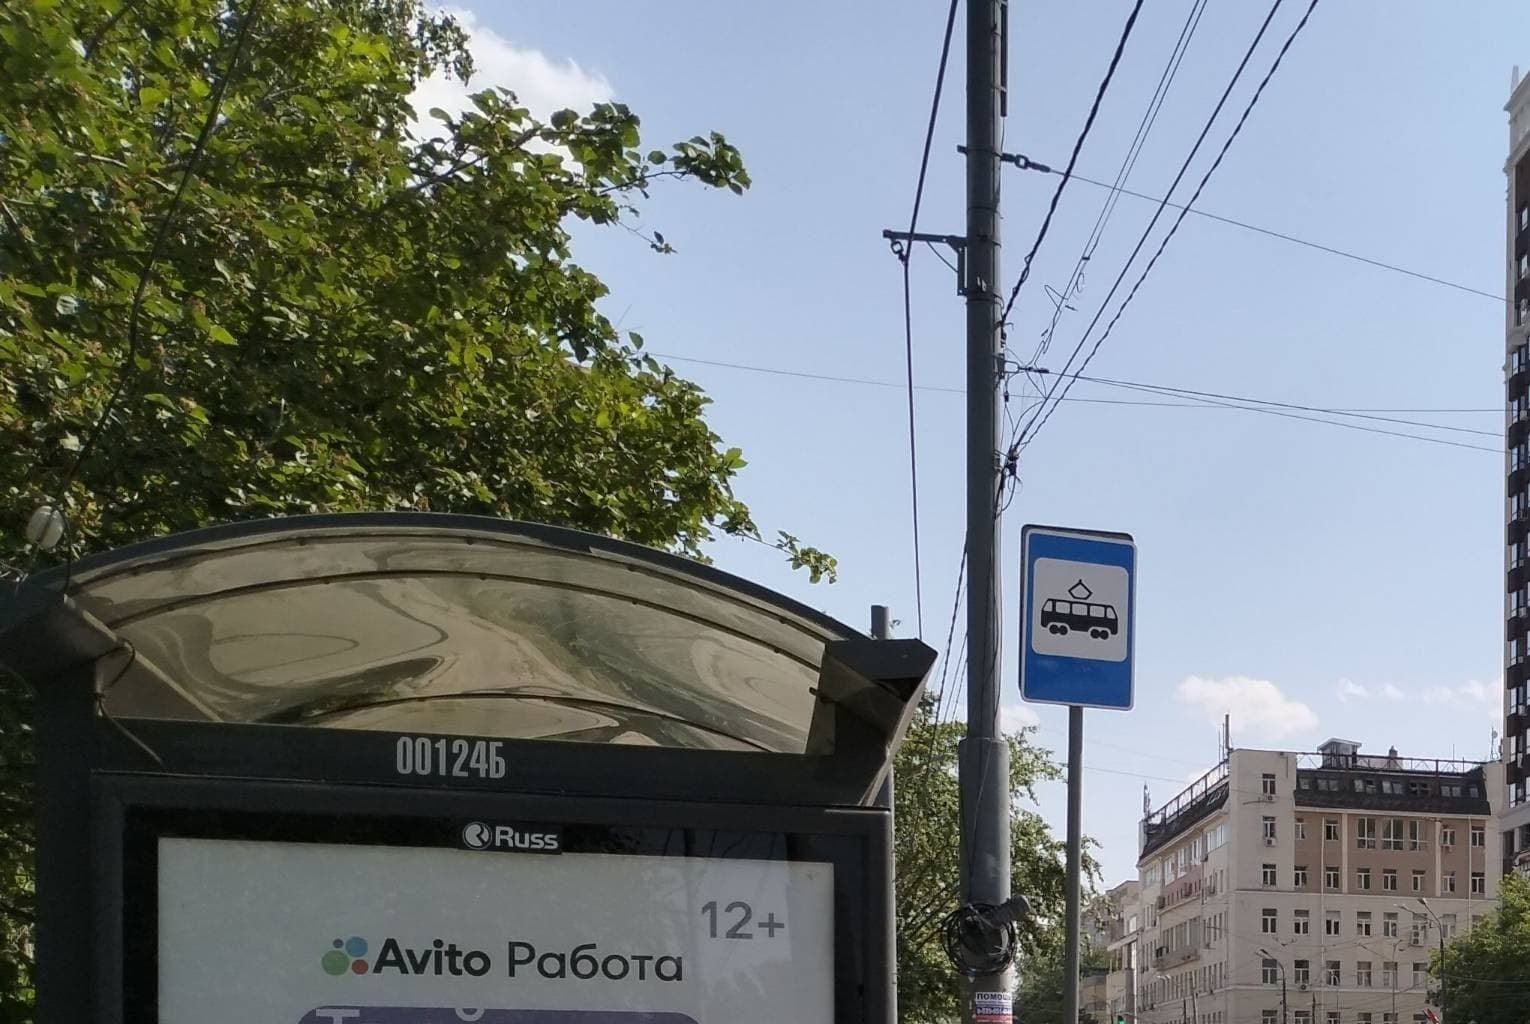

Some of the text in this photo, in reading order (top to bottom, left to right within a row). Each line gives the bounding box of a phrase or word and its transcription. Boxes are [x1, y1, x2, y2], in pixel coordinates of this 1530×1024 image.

[397, 736, 506, 779] 00124Б
[495, 826, 559, 850] Russ
[700, 901, 785, 940] 12+
[373, 938, 683, 982] Avito Работа
